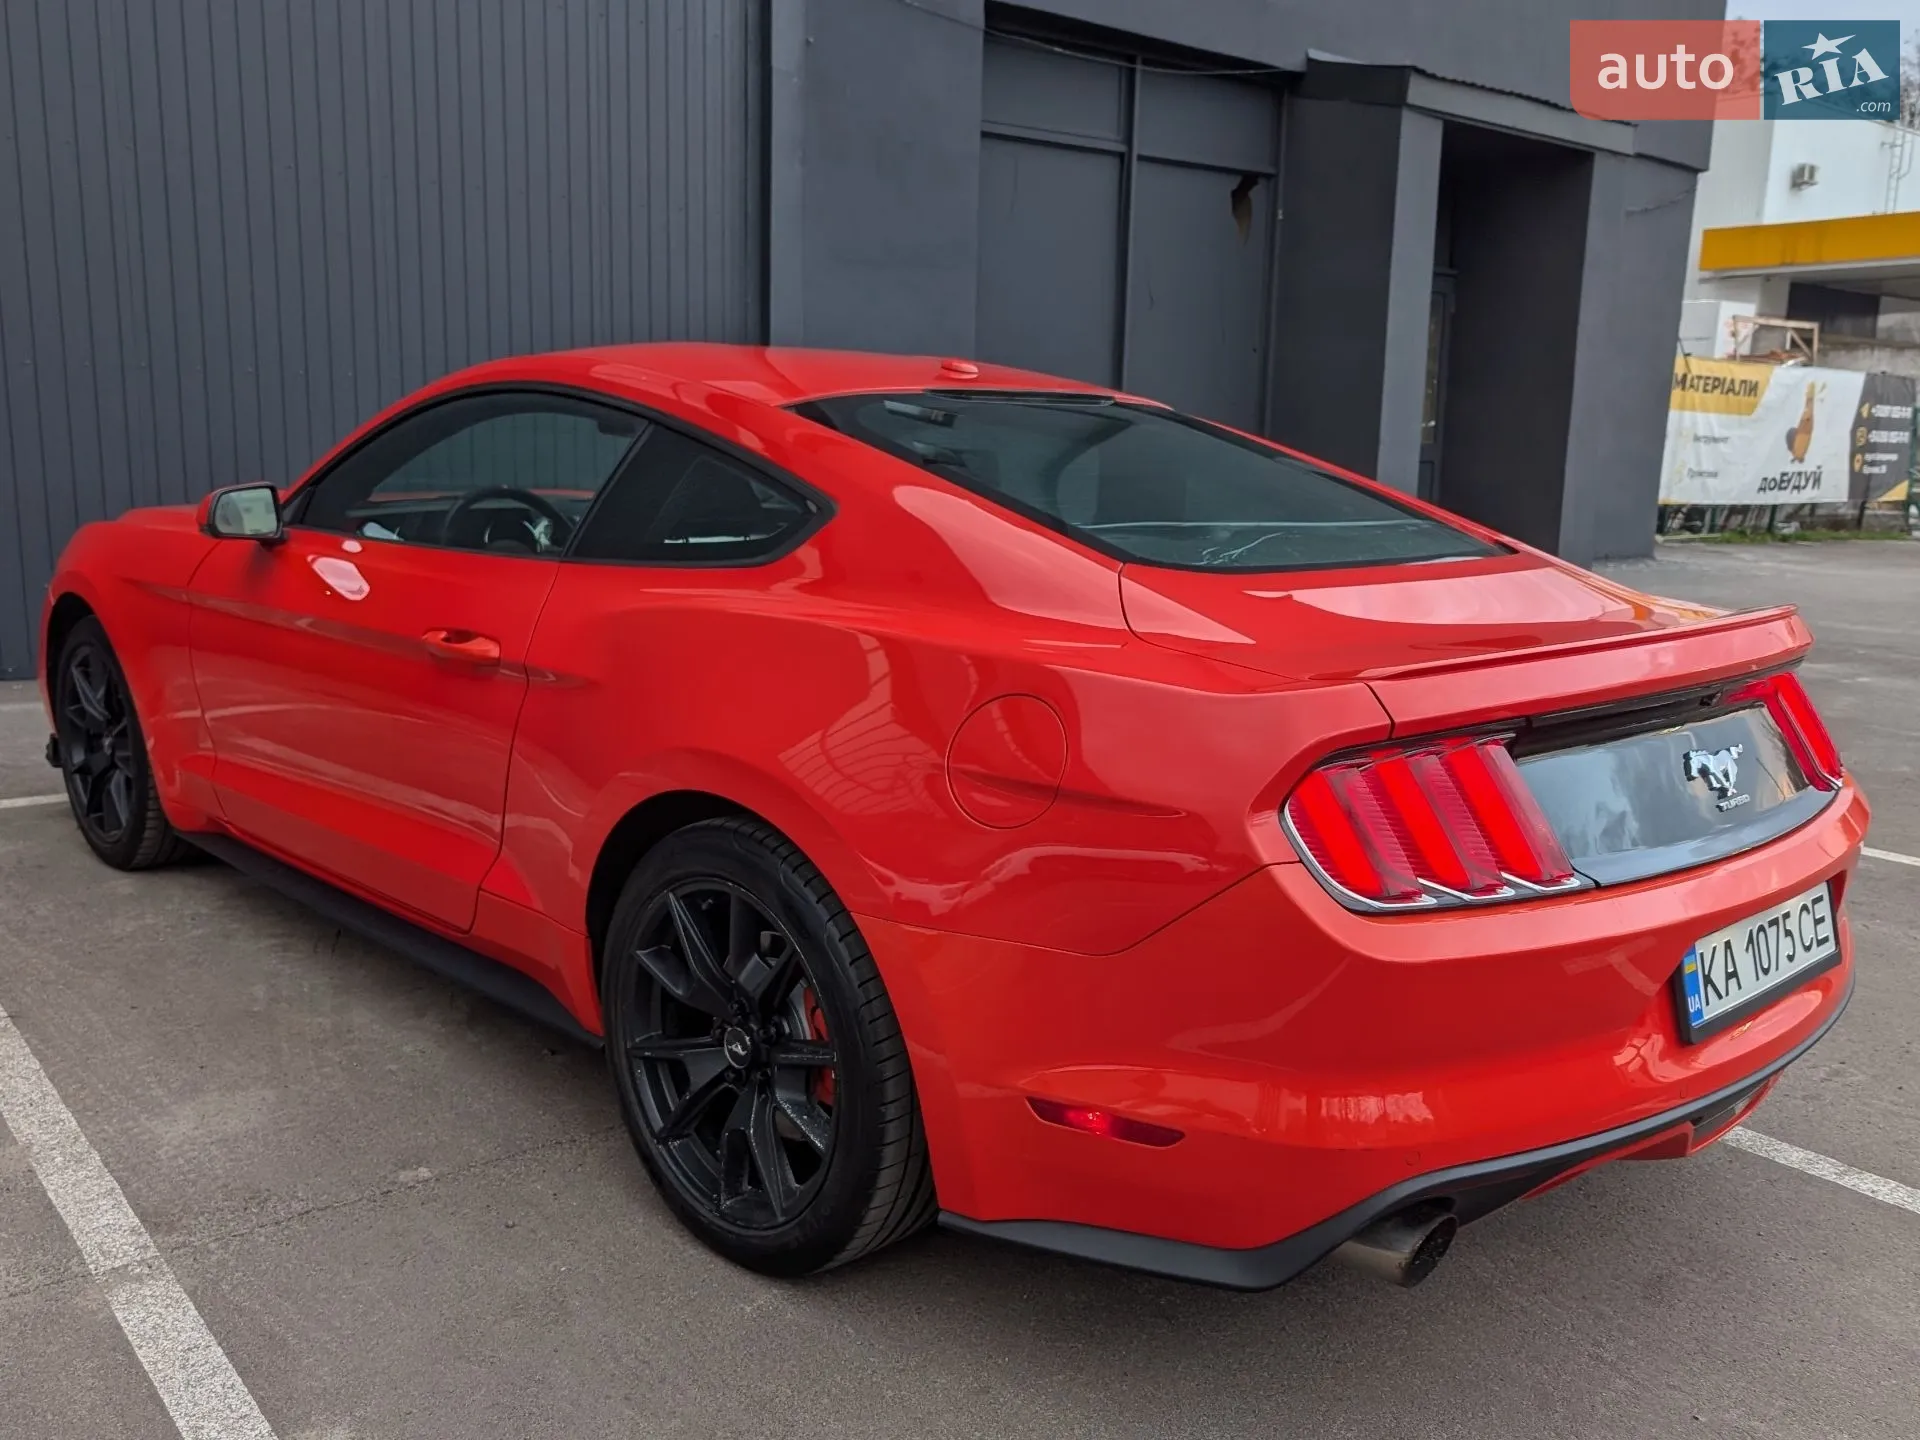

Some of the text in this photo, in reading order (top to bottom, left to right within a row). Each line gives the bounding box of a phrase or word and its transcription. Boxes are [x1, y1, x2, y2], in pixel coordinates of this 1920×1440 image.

[1672, 372, 1760, 398] МАТЕРІАЛИ
[1716, 794, 1751, 812] TURBO
[1699, 894, 1830, 1007] KA 1075 CE
[1687, 993, 1701, 1013] UA
